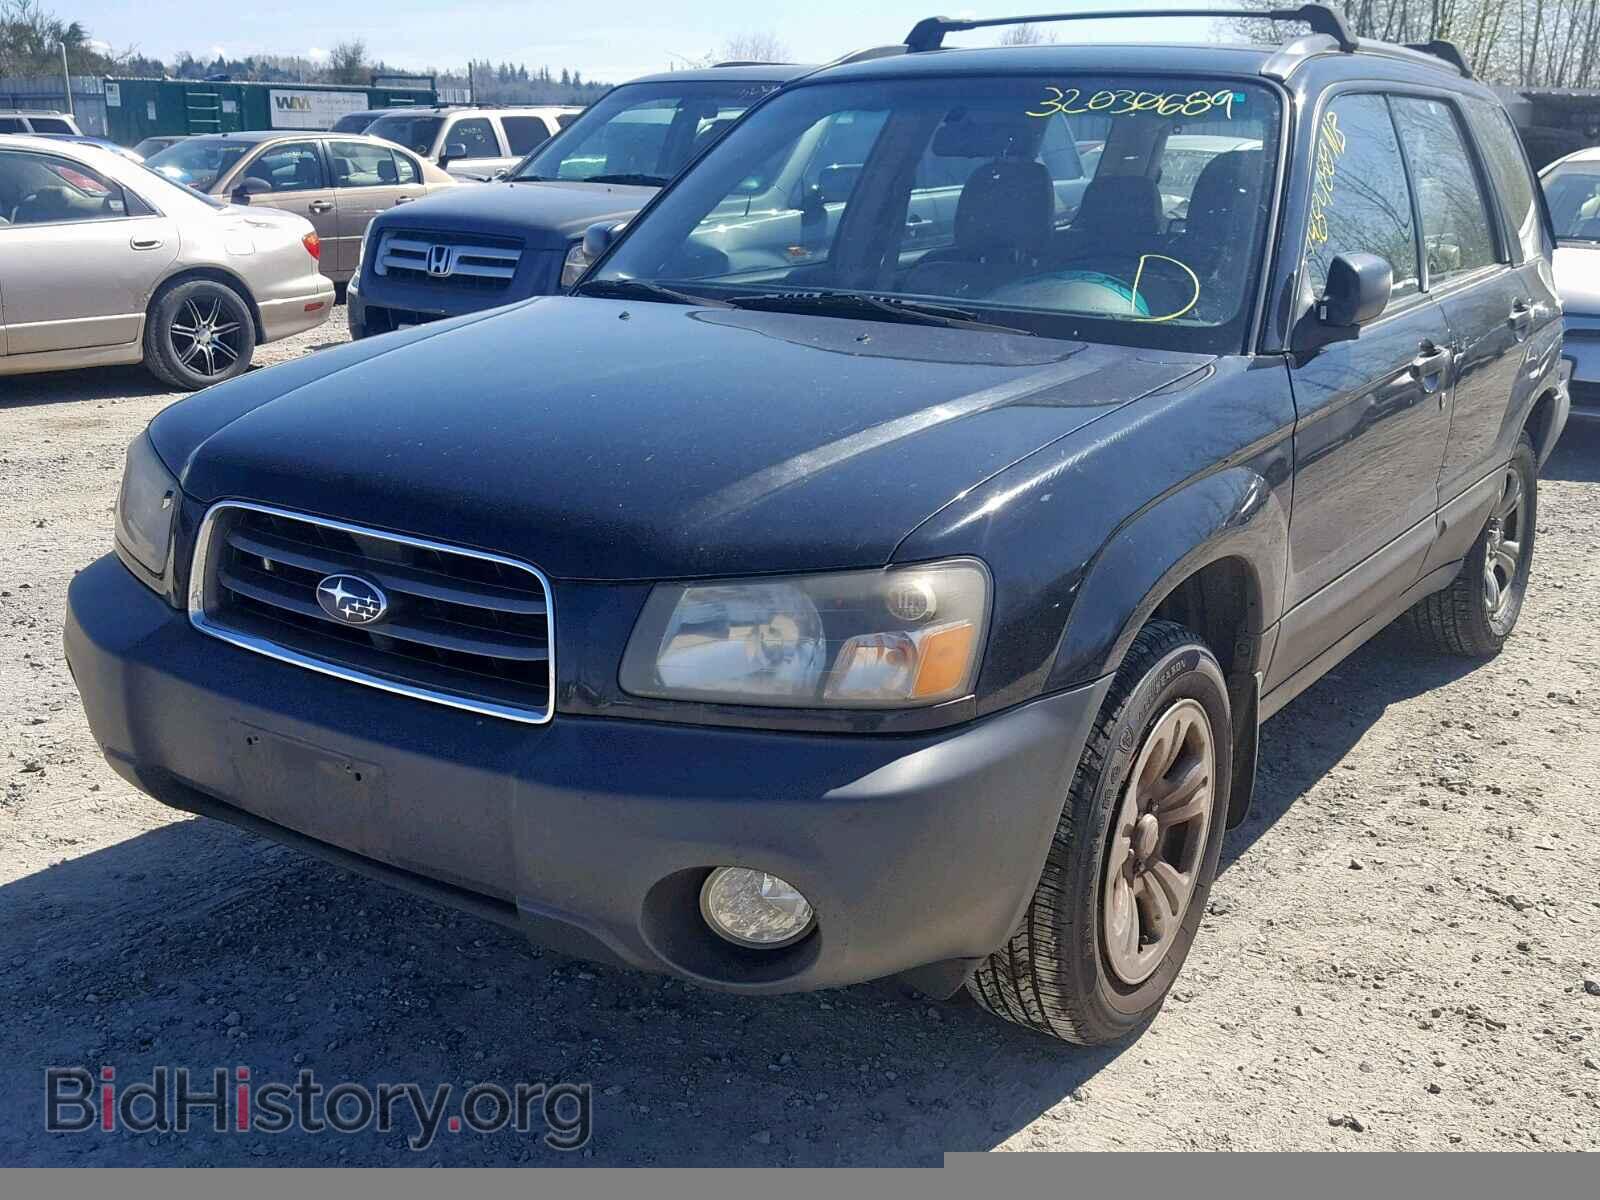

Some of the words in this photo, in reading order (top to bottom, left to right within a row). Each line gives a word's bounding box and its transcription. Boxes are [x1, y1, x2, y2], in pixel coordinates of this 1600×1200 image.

[275, 96, 313, 109] WM
[1025, 87, 1233, 119] 32030689
[1131, 254, 1200, 322] D
